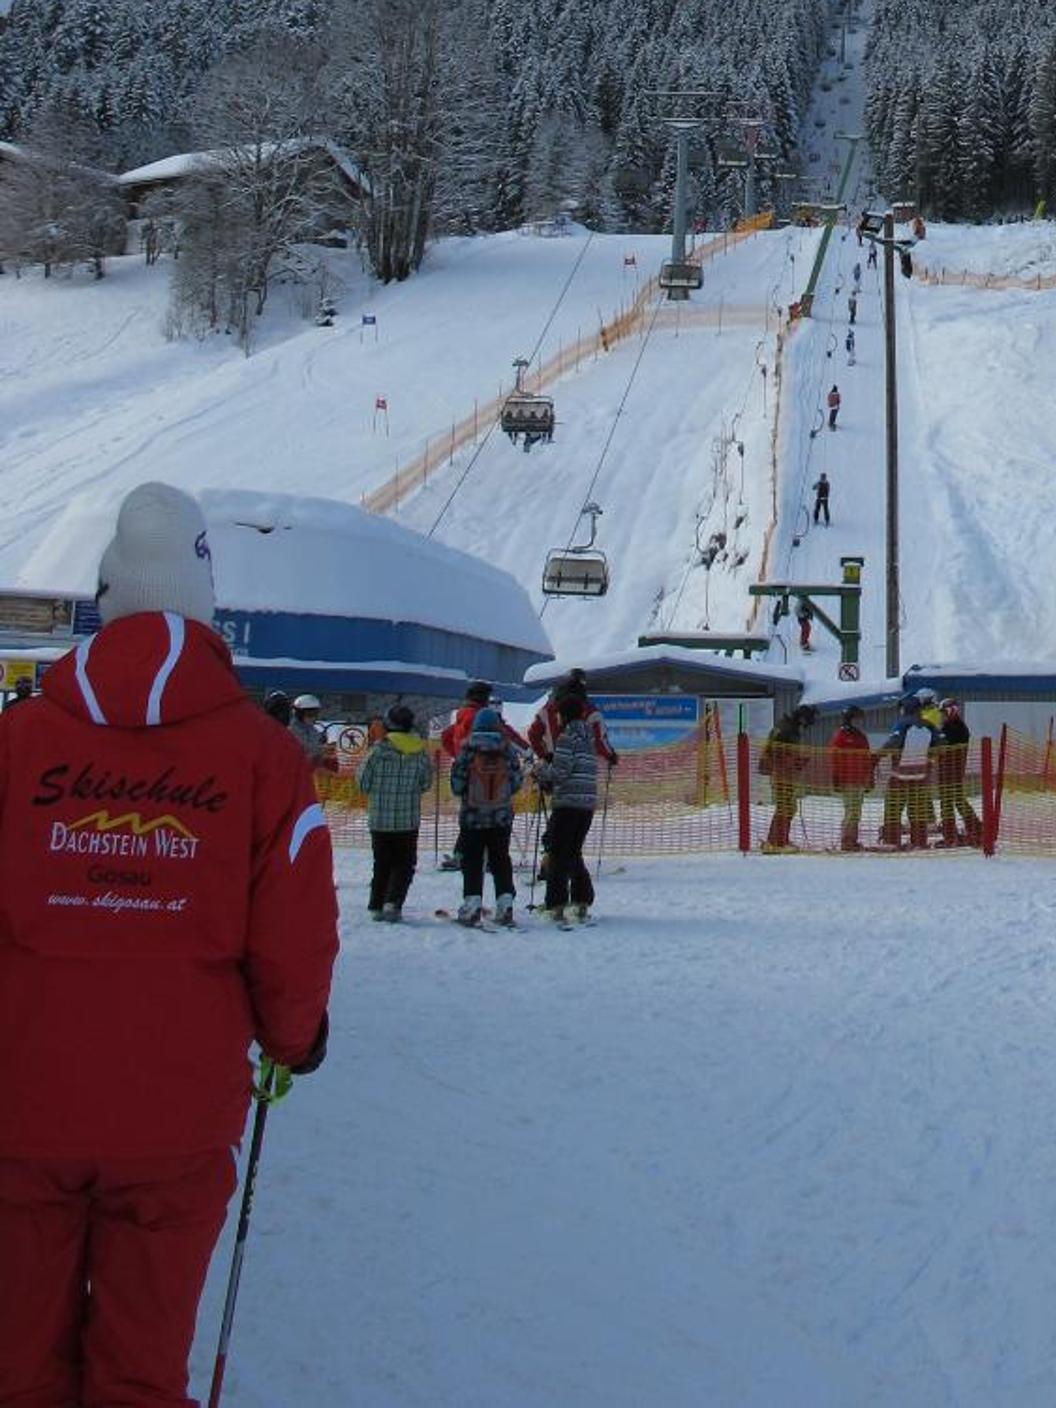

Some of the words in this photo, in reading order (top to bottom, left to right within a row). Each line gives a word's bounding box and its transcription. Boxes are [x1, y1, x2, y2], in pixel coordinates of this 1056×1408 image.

[32, 762, 228, 813] Skischule
[50, 821, 148, 857] DACHSTEIN
[155, 828, 200, 859] WEST
[87, 865, 151, 886] Gosau
[48, 891, 188, 913] www.skigosau.at
